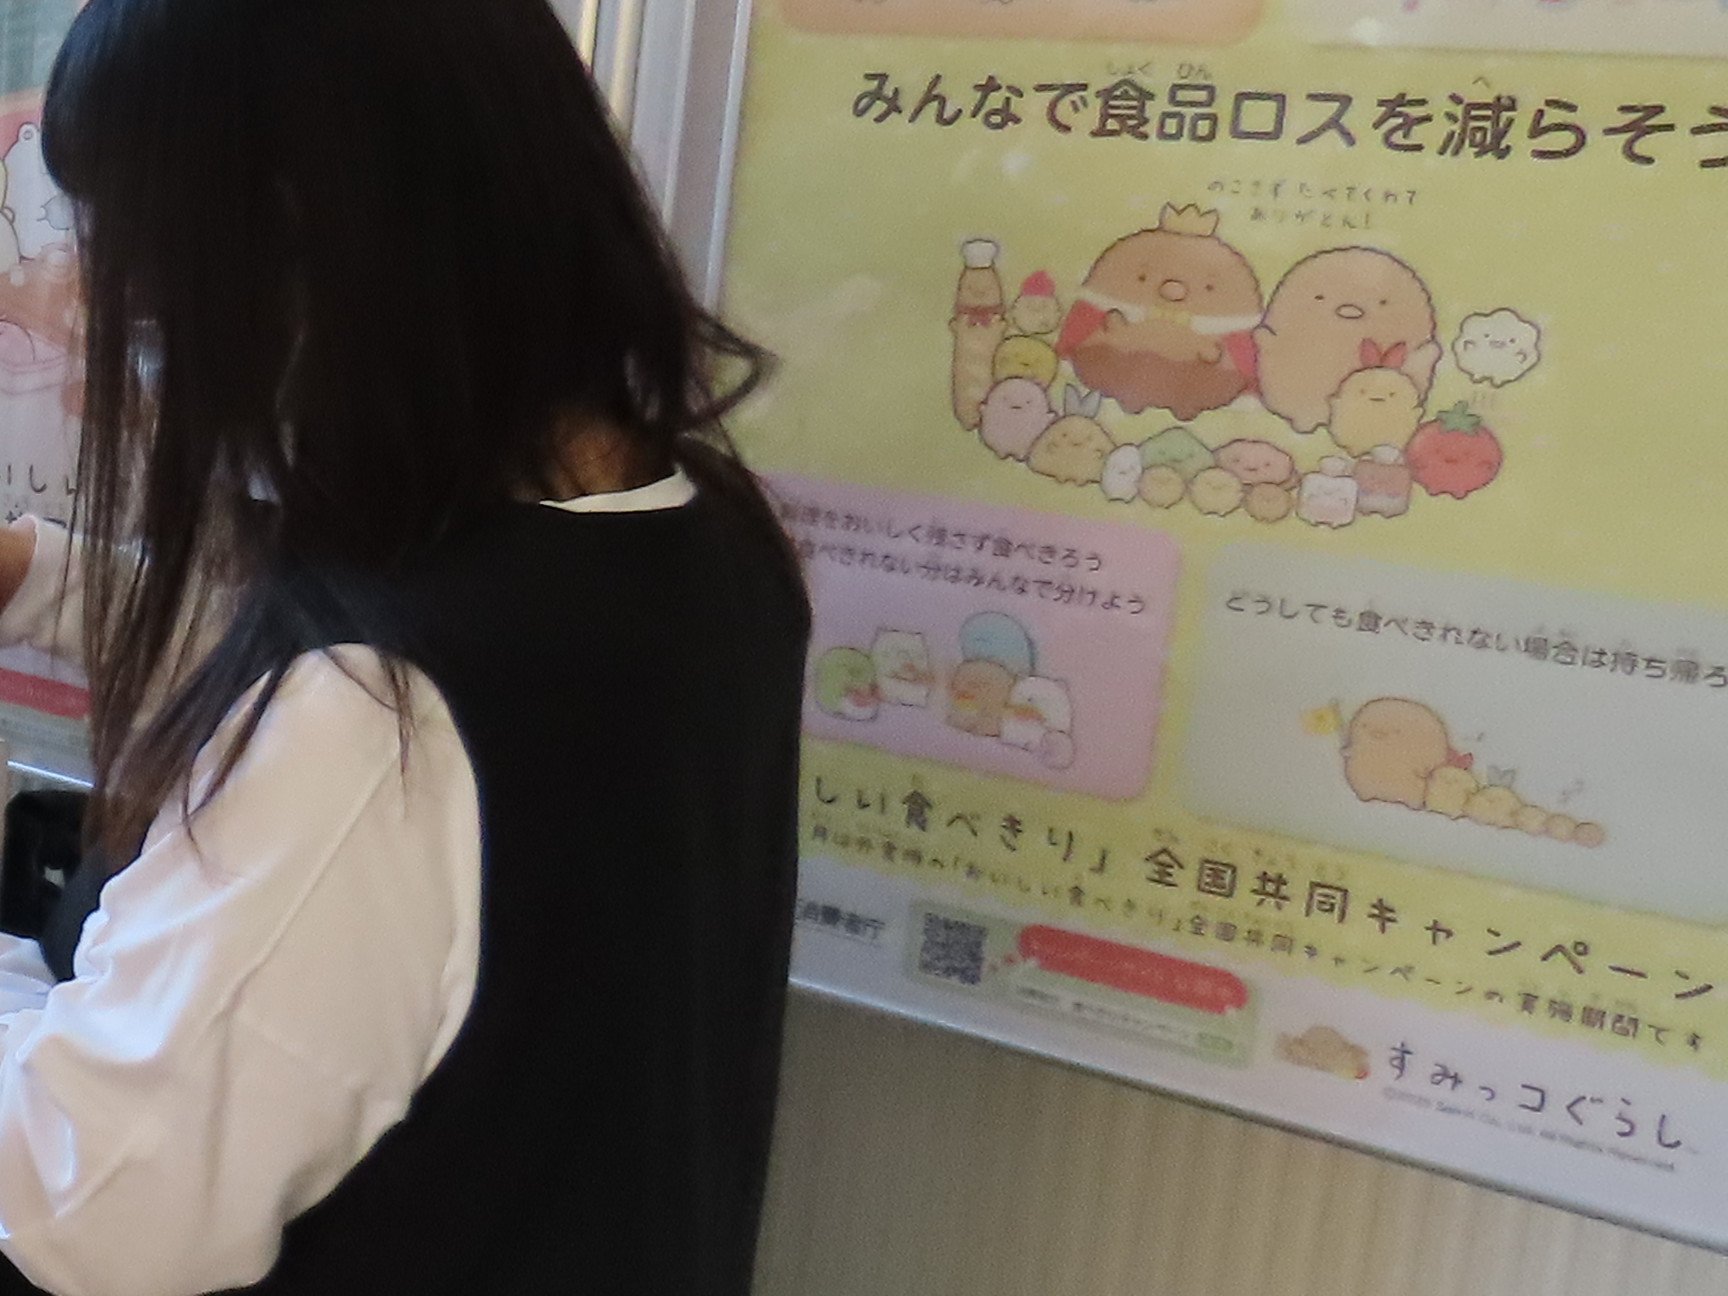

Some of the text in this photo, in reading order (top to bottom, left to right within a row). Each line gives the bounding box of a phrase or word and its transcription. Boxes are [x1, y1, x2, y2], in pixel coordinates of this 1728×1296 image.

[1389, 1041, 1683, 1149] すみっコぐらし
